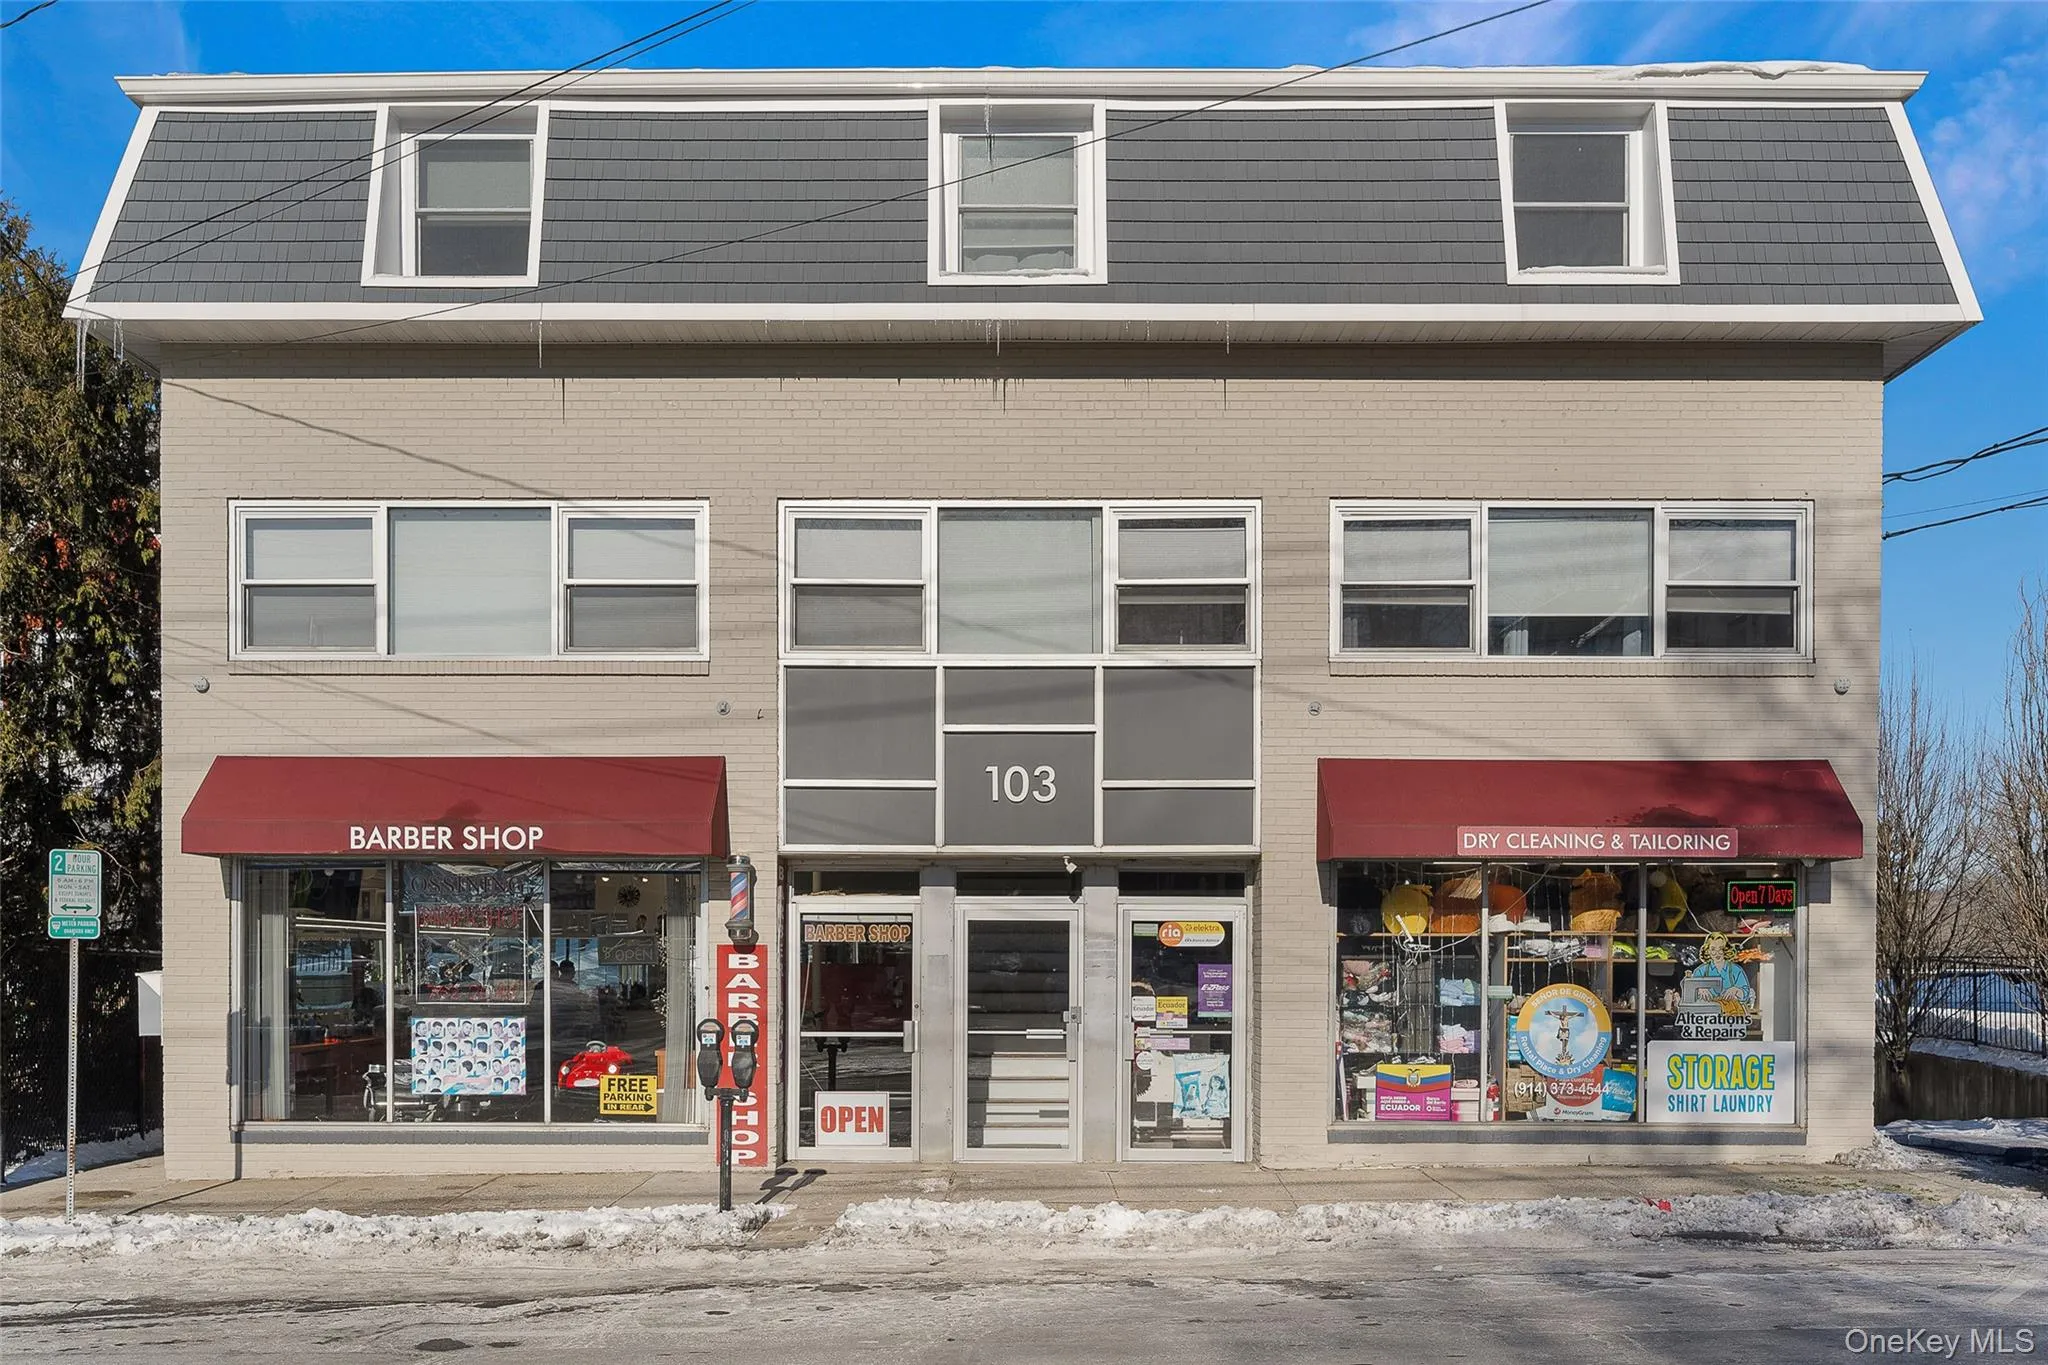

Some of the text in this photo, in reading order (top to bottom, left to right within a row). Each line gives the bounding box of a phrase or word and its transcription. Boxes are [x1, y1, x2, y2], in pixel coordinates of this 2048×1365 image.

[985, 765, 1057, 803] 103
[350, 826, 544, 850] BARBER SHOP
[1463, 833, 1731, 851] DRY CLEANING & TAILORING
[54, 854, 63, 872] 2
[72, 854, 91, 864] HOUR
[67, 864, 97, 873] PARKING
[411, 874, 525, 894] OSSINING
[1731, 885, 1793, 909] Open 7 Days
[804, 924, 911, 942] BARBER SHOP
[1162, 924, 1181, 937] ria
[1193, 924, 1220, 932] elektra
[615, 949, 653, 961] OPEN
[1158, 1001, 1186, 1009] Ecuador
[1676, 1012, 1751, 1025] Alterations
[1682, 1026, 1746, 1040] & Repairs
[1520, 1036, 1537, 1063] Rental
[1536, 1059, 1556, 1074] Place
[1567, 1065, 1581, 1075] Dry
[1582, 1036, 1607, 1068] Cleaning
[1667, 1053, 1776, 1090] STORAGE
[607, 1078, 649, 1092] FREE
[1514, 1082, 1547, 1097] (914)
[1550, 1082, 1610, 1095] 373-4544
[603, 1093, 652, 1102] PARKING
[1668, 1094, 1773, 1113] SHIRT LAUNDRY
[619, 1103, 645, 1111] REAR
[820, 1105, 884, 1133] OPEN
